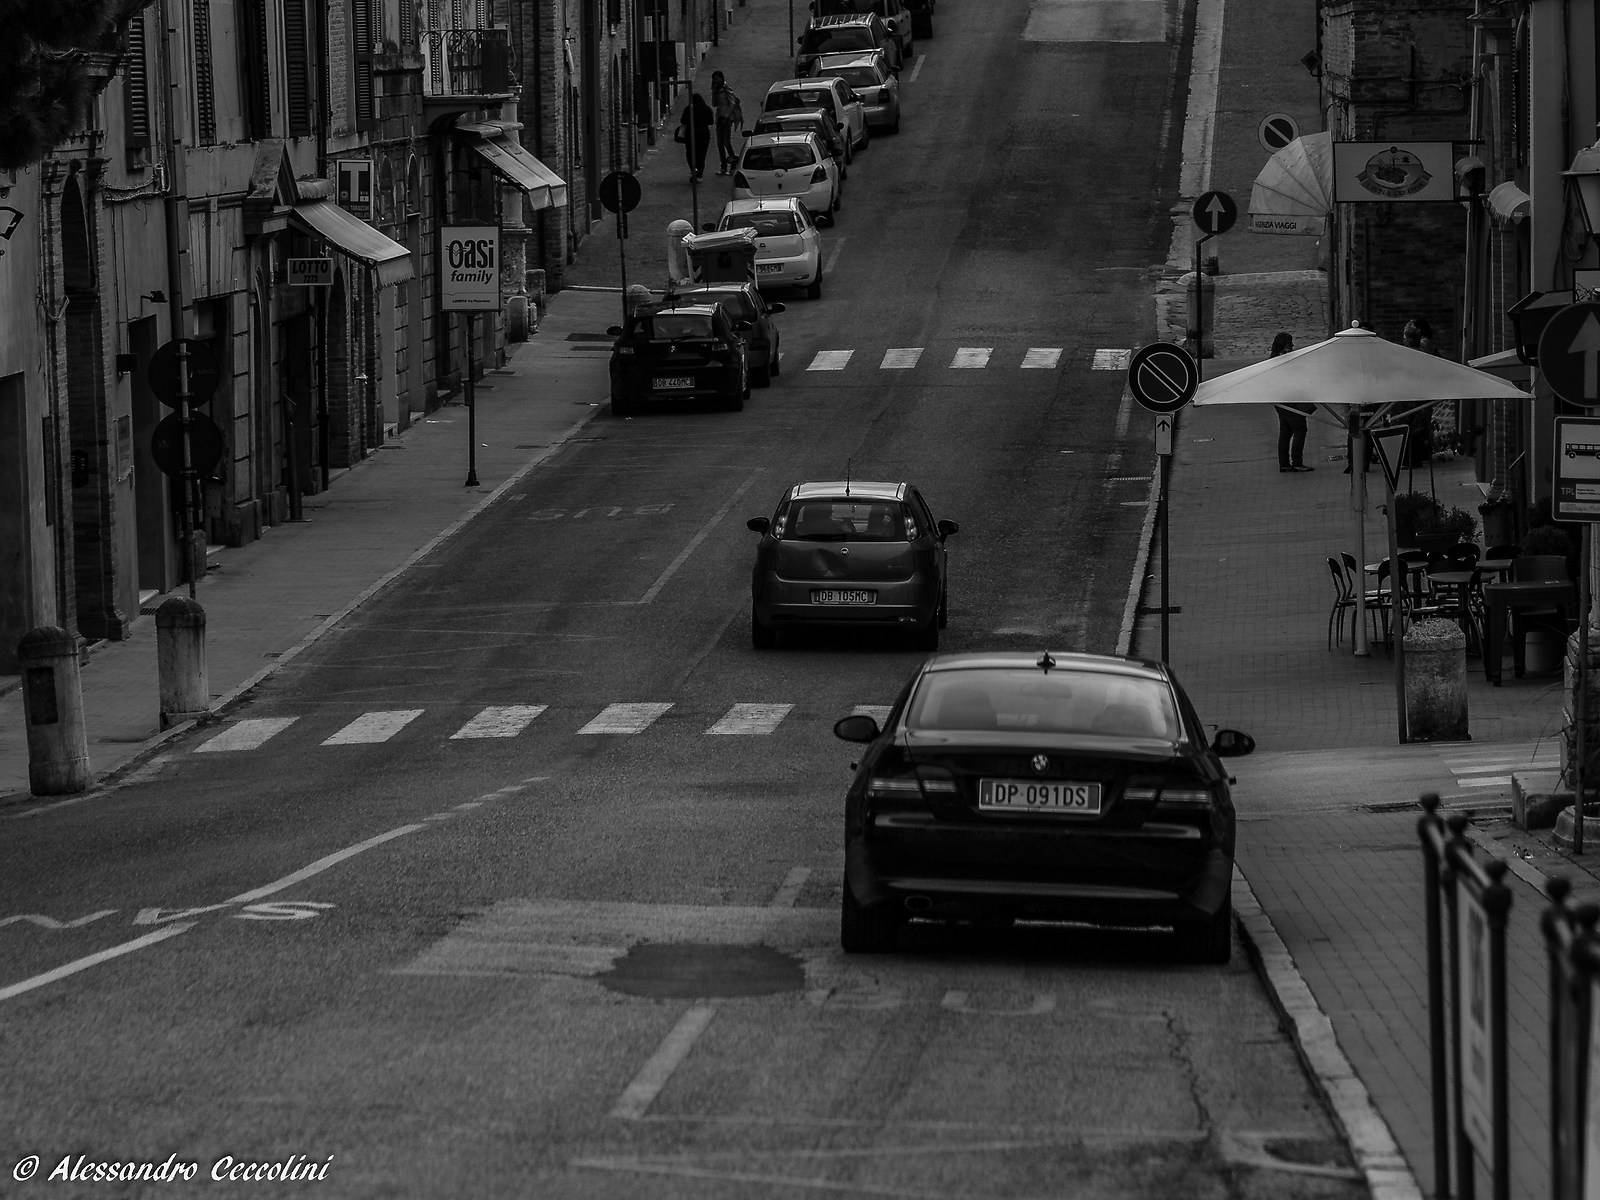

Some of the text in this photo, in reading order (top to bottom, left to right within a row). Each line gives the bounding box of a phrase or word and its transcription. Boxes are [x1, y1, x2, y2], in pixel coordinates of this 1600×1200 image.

[341, 163, 368, 202] T
[1274, 221, 1297, 230] VIAGGI
[292, 260, 328, 274] LOTTO
[451, 270, 493, 285] family
[821, 591, 867, 602] DB 105MC
[995, 784, 1018, 804] DP
[1026, 785, 1086, 806] 091DS
